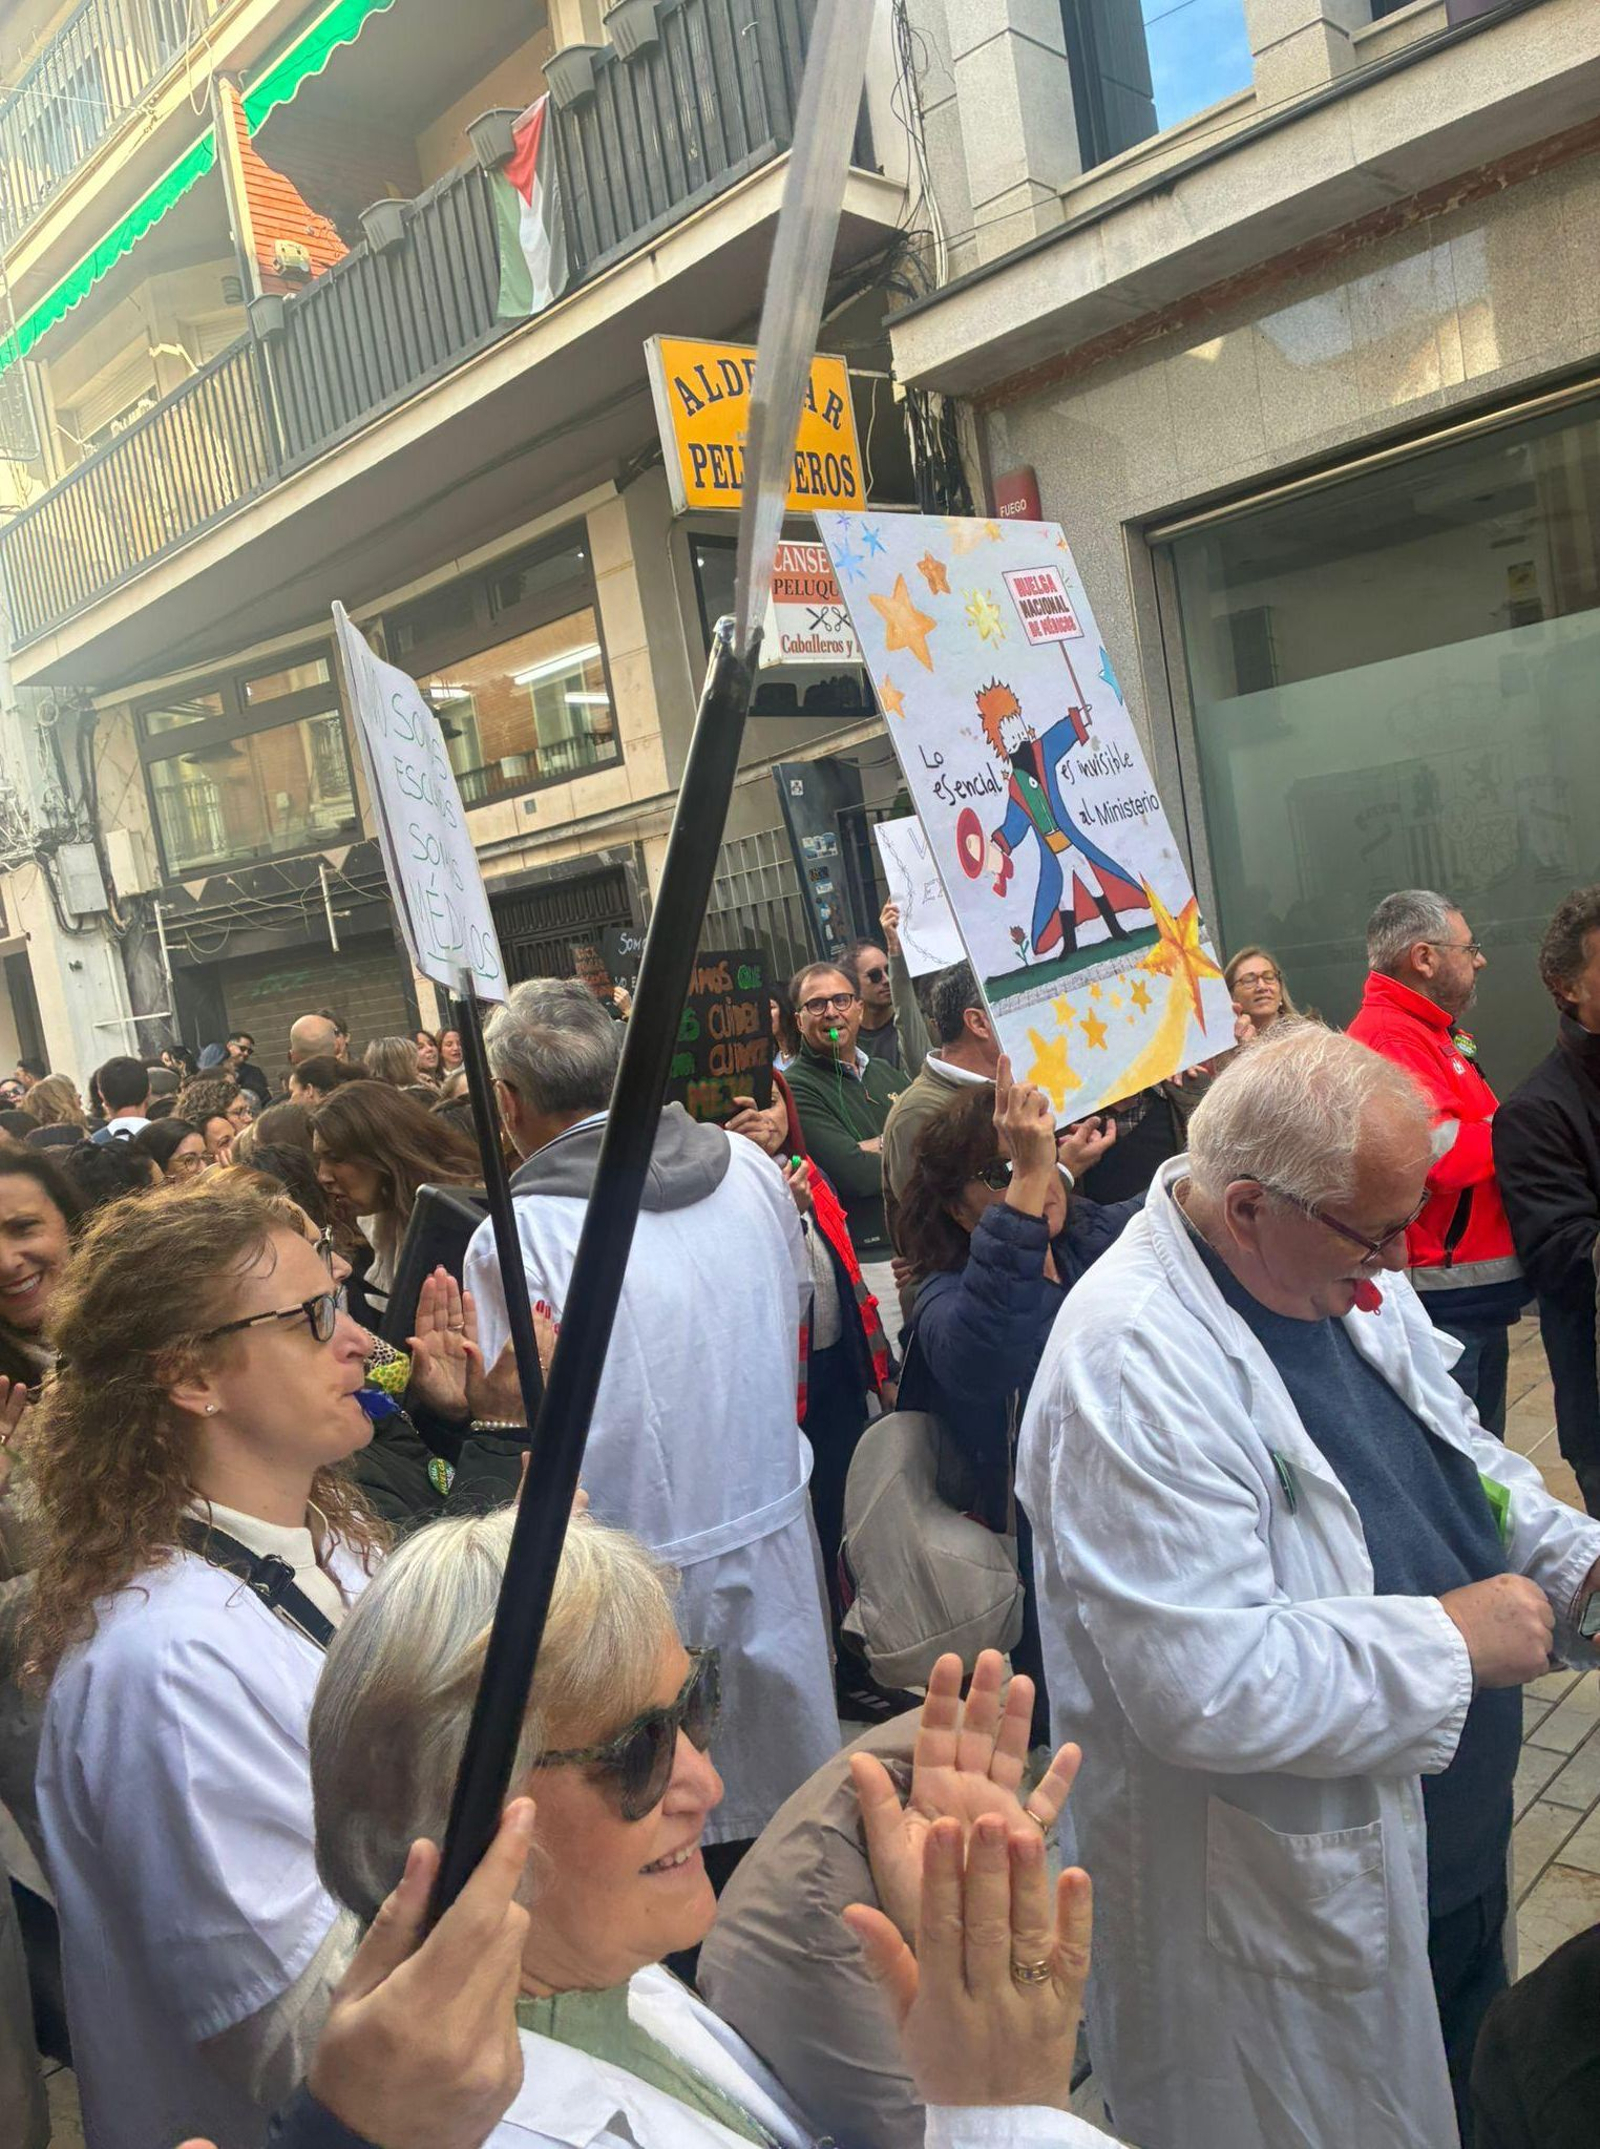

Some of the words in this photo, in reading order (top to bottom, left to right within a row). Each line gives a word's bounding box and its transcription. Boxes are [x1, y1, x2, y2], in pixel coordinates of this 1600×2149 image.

[688, 442, 856, 498] PELEROS
[1000, 498, 1027, 517] FUEGO
[1013, 573, 1058, 598] HUELGA
[1019, 595, 1070, 619] NACIONAL
[1028, 620, 1043, 637] DE
[781, 633, 844, 654] Caballeros
[845, 639, 853, 658] y
[918, 745, 944, 768] Lo
[1060, 762, 1077, 785] es
[1077, 741, 1134, 777] invisible
[932, 762, 1003, 806] esencial
[1079, 798, 1096, 825] al
[1093, 791, 1160, 827] Ministerio
